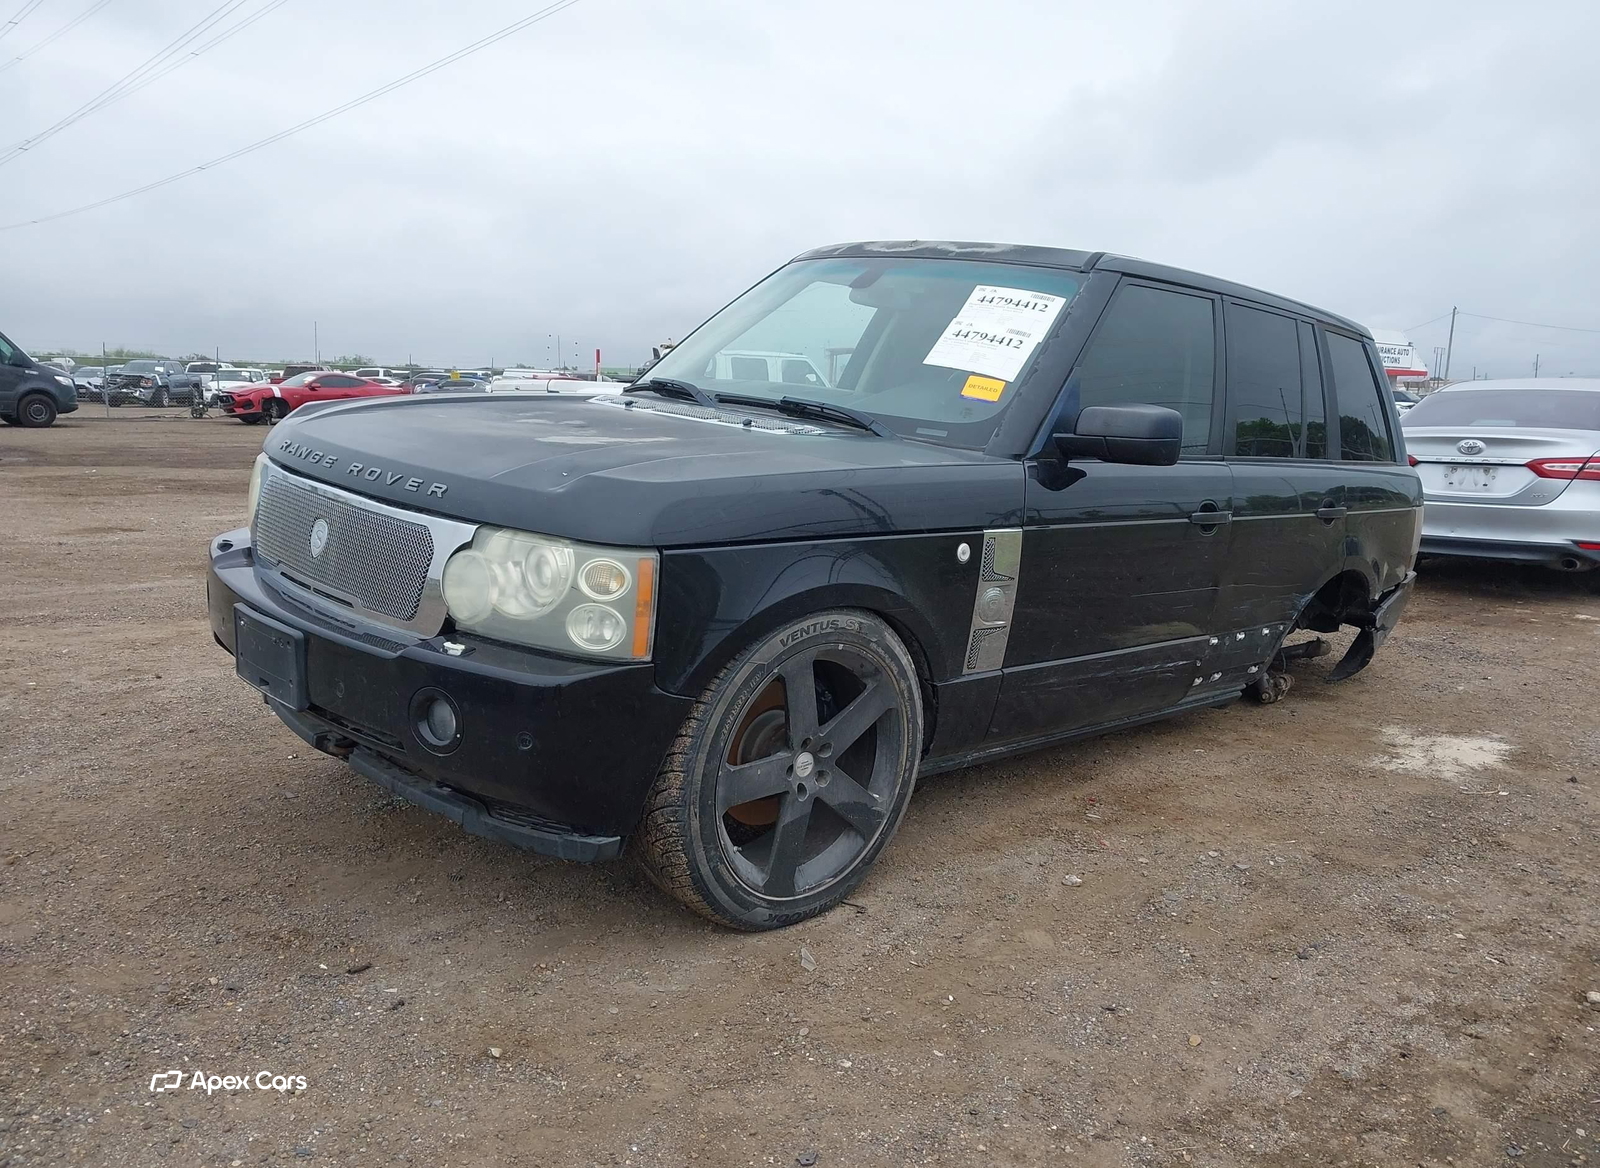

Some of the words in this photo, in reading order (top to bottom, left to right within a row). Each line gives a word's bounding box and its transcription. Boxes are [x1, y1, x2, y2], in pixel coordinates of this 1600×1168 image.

[977, 295, 1049, 312] 44794412
[952, 329, 1024, 349] 44794412
[1397, 348, 1409, 356] AUTO
[968, 384, 998, 393] DETAILED
[279, 439, 338, 469] RANGE
[346, 462, 448, 498] ROVER
[779, 619, 840, 647] VENTUS
